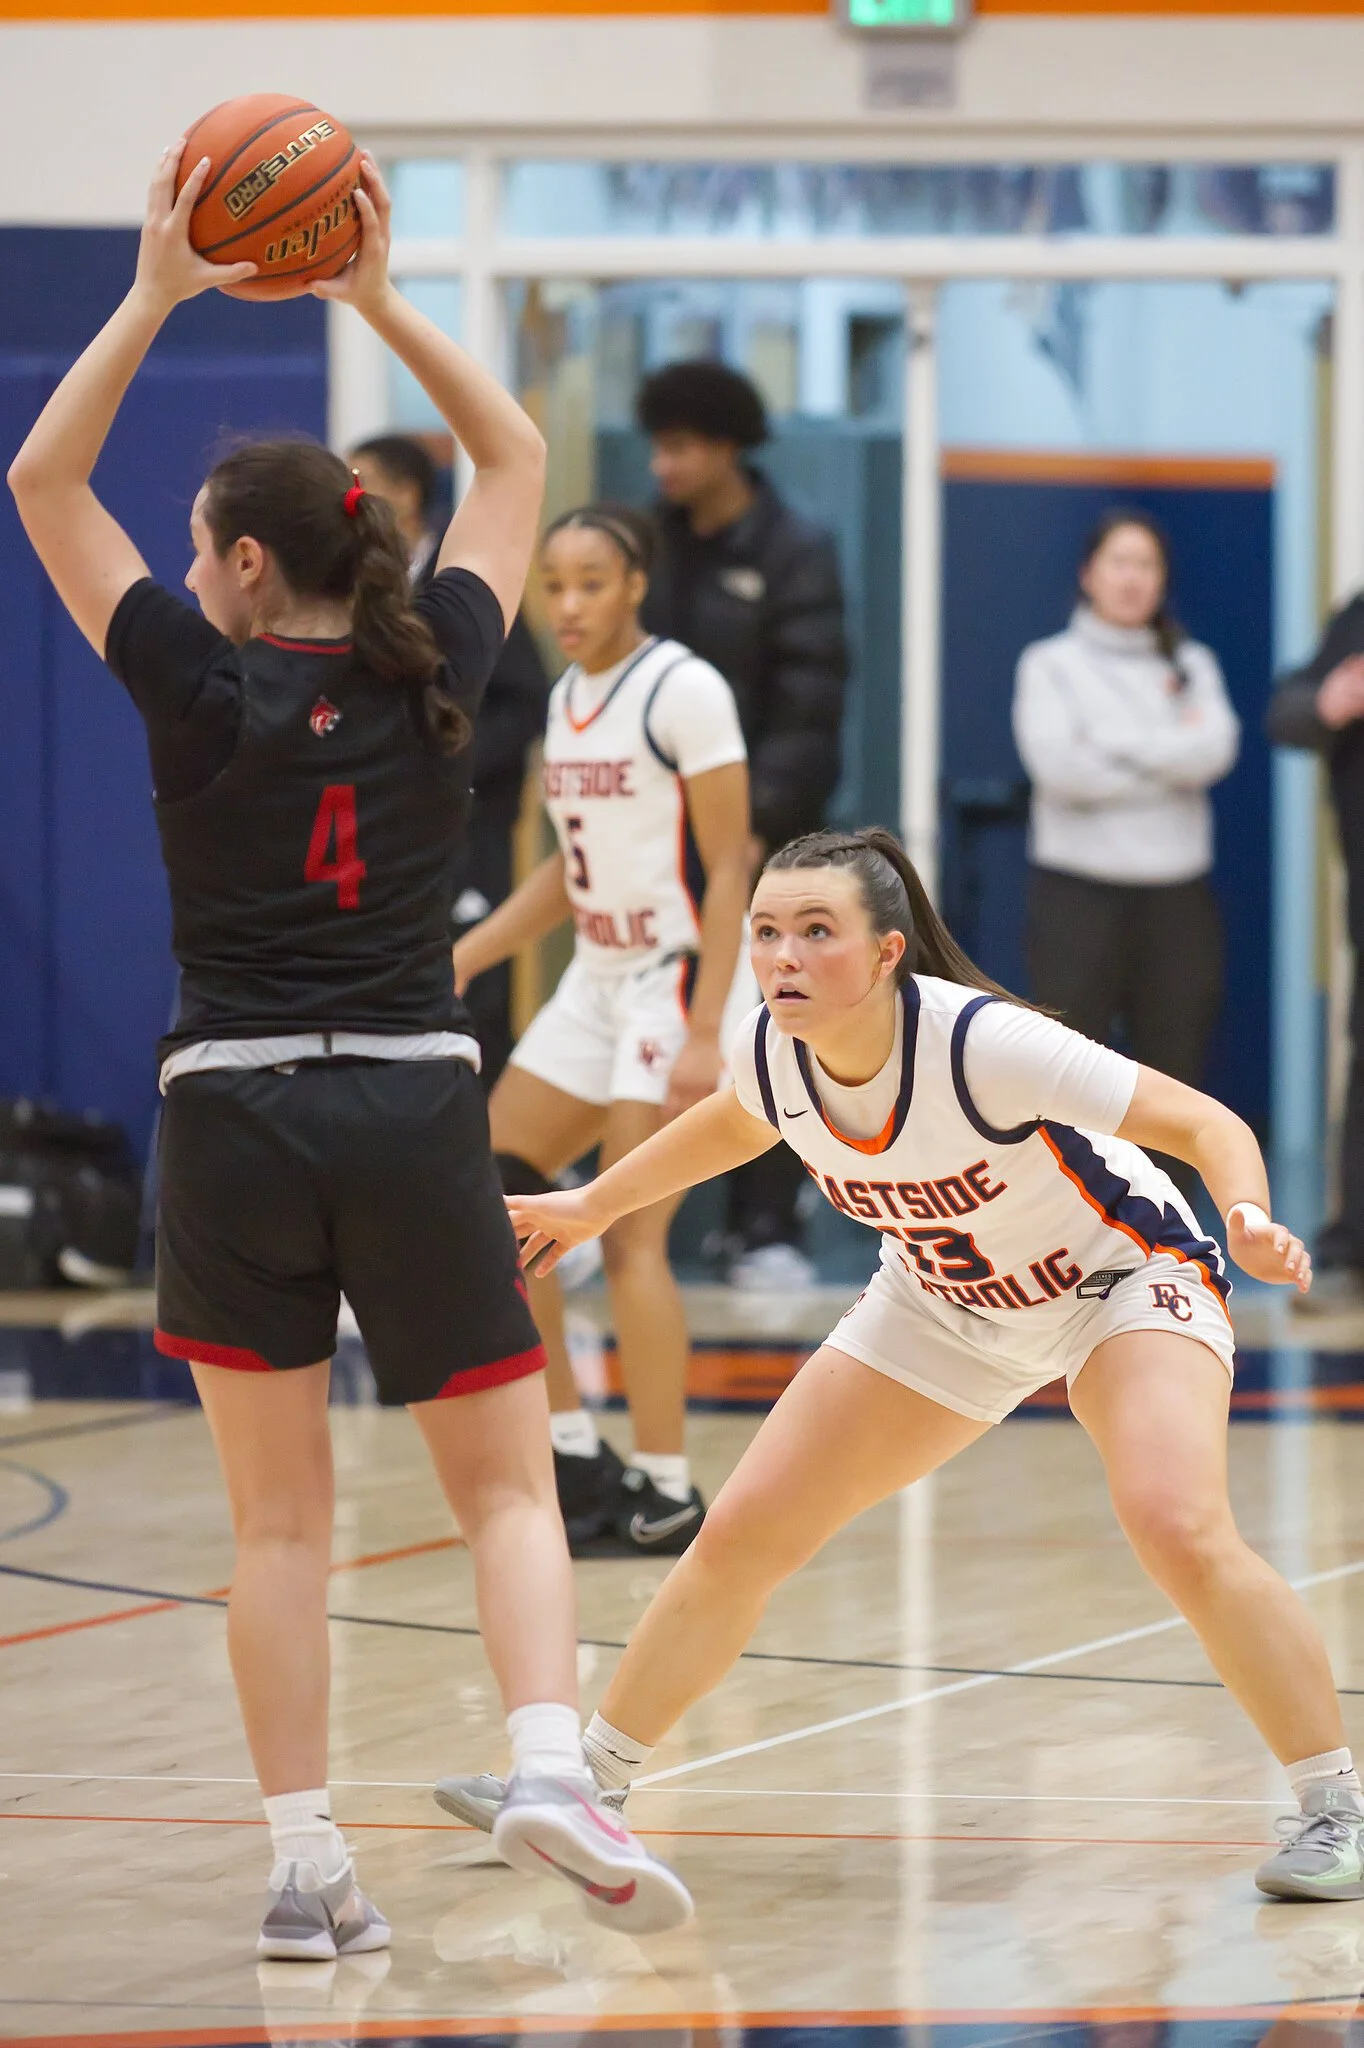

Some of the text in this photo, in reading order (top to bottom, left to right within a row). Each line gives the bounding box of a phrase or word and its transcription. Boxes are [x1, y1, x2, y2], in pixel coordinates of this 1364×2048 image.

[264, 187, 362, 264] aden
[304, 783, 368, 910] 4
[1148, 1283, 1193, 1323] EC
